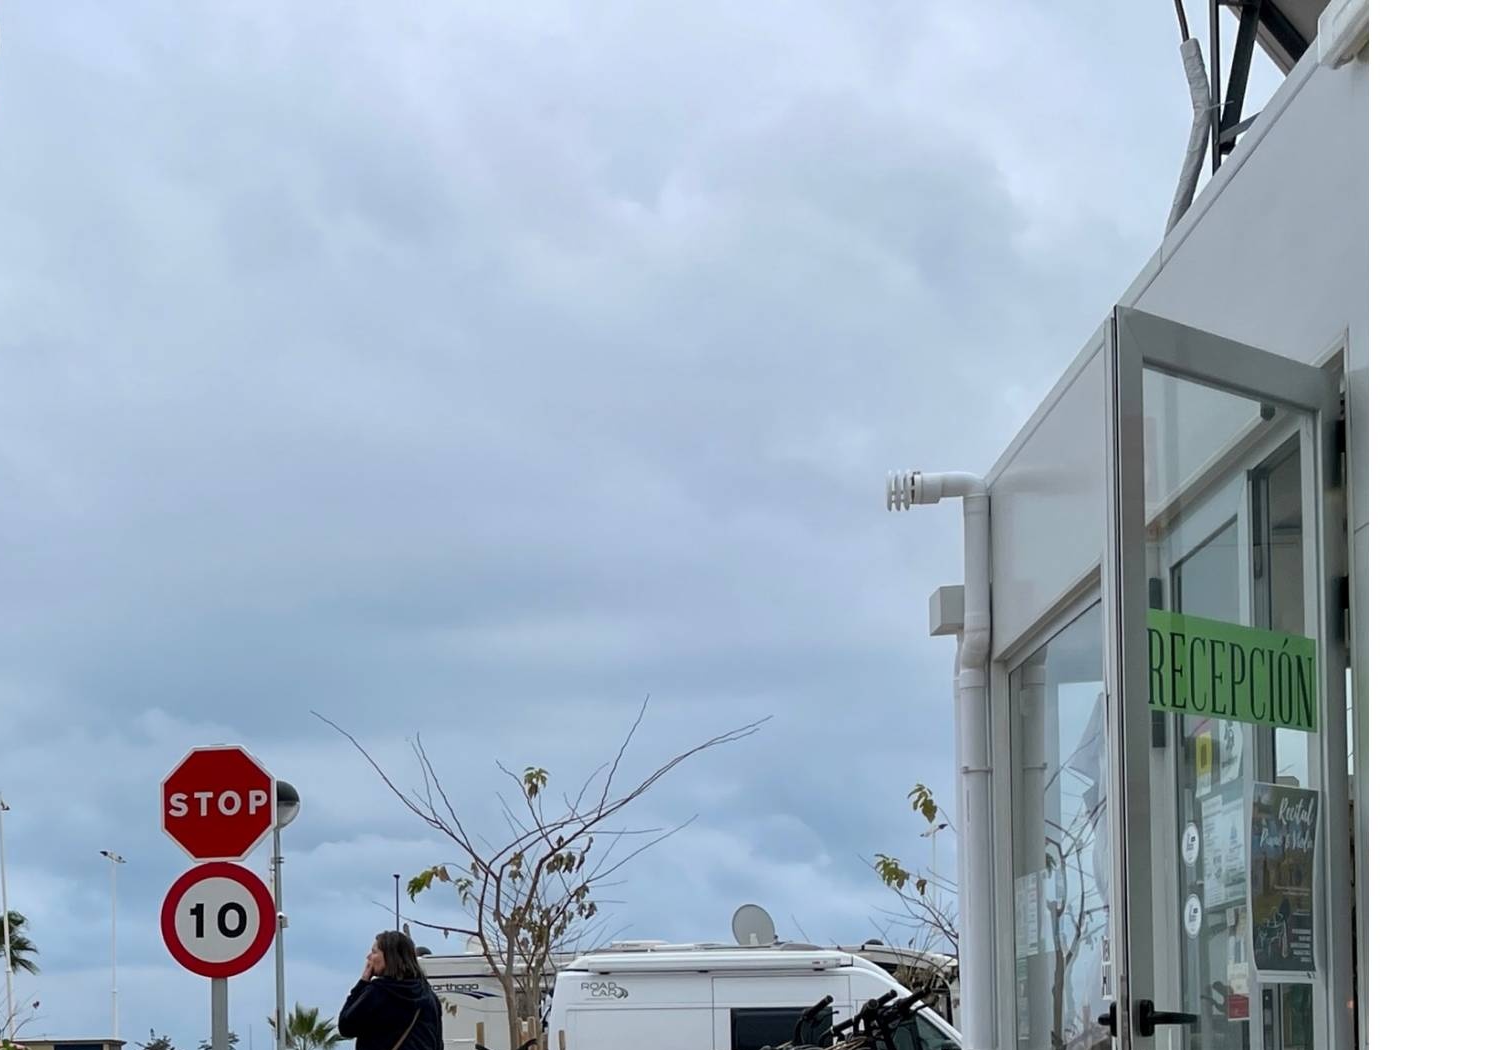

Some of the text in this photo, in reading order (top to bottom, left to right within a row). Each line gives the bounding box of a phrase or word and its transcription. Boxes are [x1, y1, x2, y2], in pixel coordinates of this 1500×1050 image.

[1146, 628, 1314, 728] RECEPCIÓN
[168, 789, 269, 817] STOP
[190, 901, 248, 939] 10
[428, 983, 479, 993] arthago
[581, 982, 617, 991] ROAD
